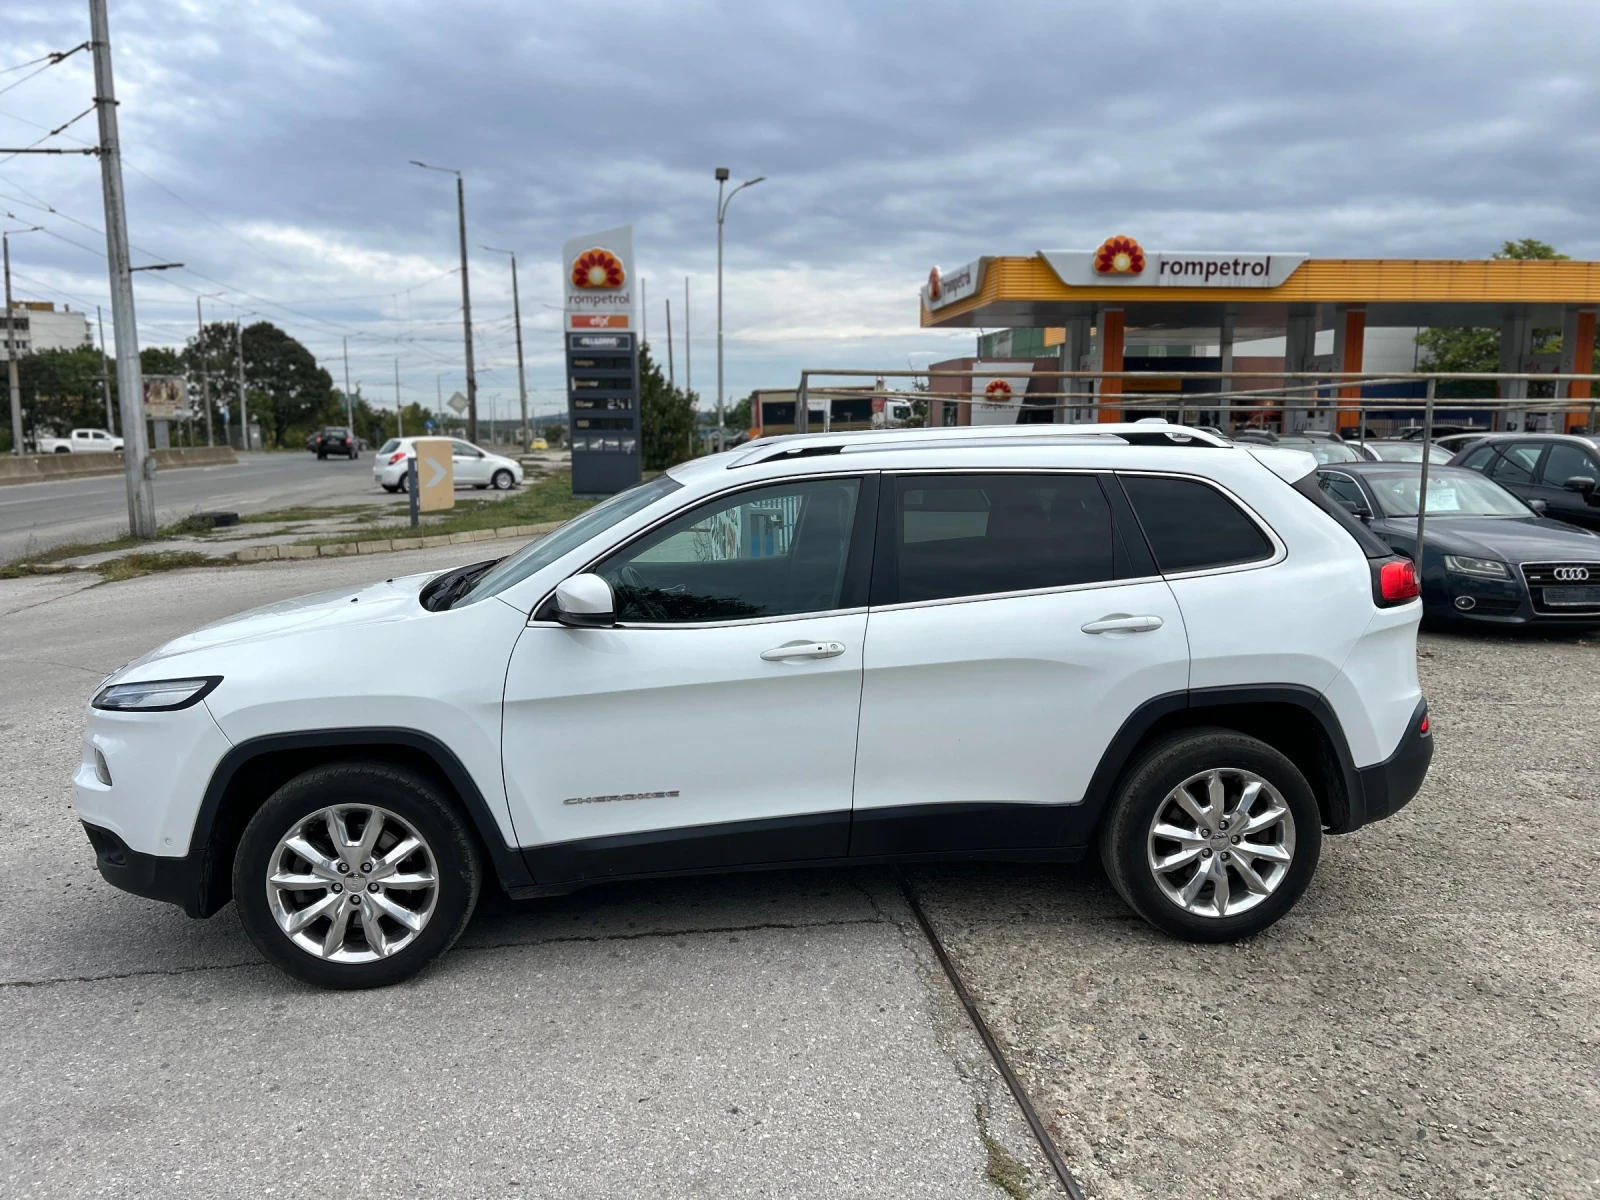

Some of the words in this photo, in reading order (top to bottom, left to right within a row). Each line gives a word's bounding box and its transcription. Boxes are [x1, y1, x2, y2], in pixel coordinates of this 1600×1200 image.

[1160, 256, 1271, 282] rompetrol
[569, 292, 630, 307] rompetrol
[563, 790, 680, 805] CHEROKEE
